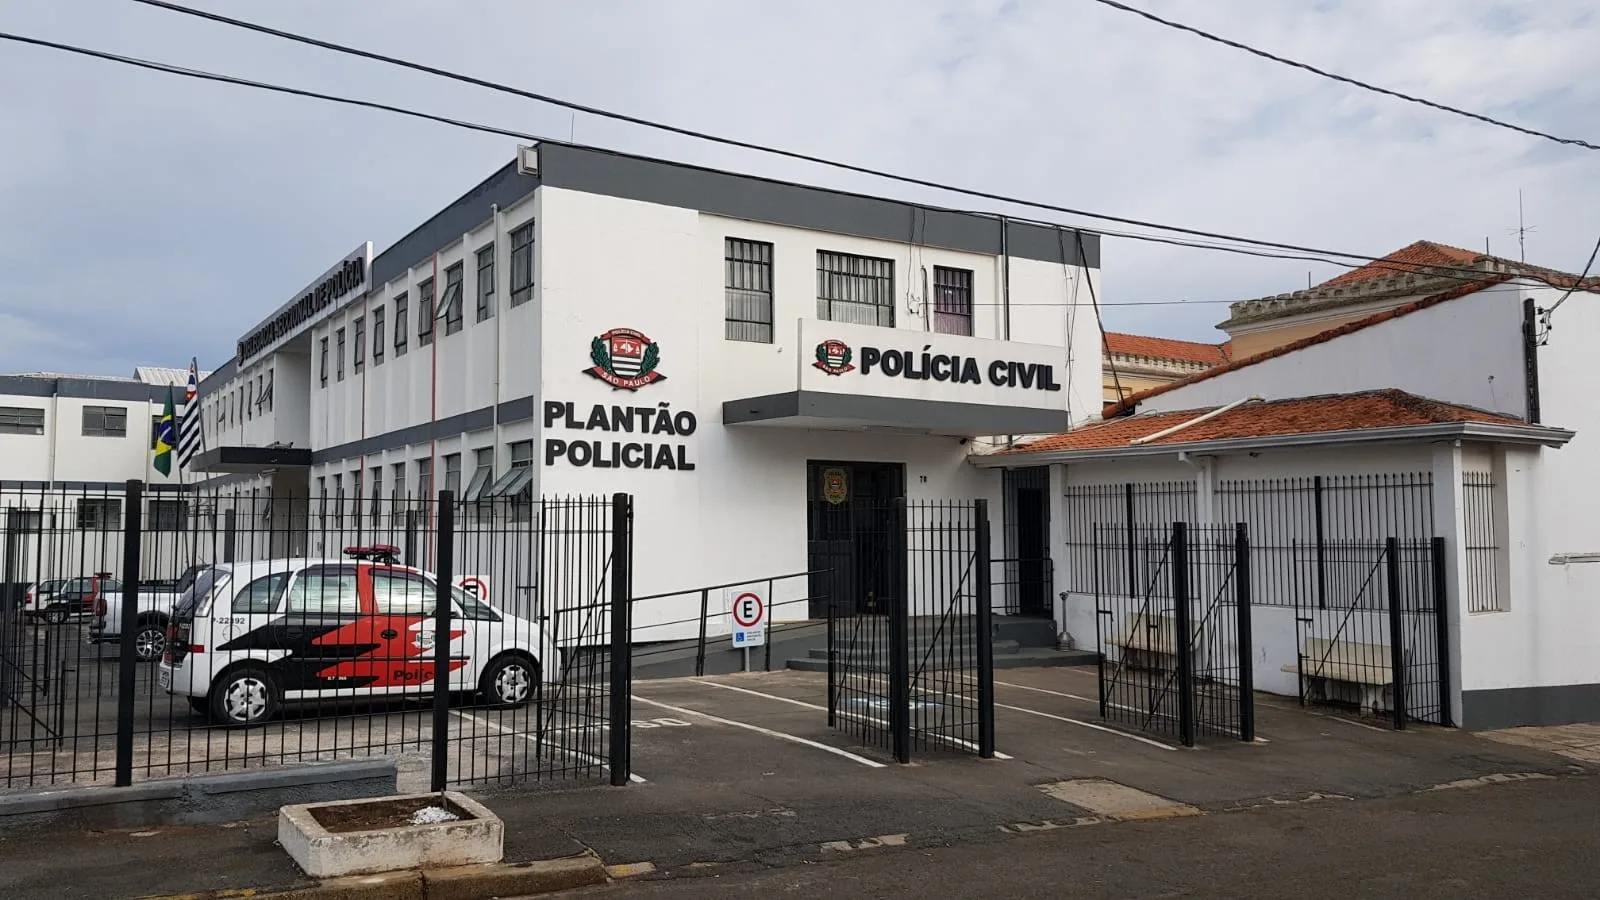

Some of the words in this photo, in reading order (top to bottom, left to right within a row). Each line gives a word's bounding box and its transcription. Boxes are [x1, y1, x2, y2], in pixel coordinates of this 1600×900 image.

[327, 256, 364, 304] POLÍCIA
[623, 376, 650, 387] PAULO
[860, 345, 981, 384] POLÍCIA
[988, 360, 1061, 391] CIVIL
[544, 401, 697, 436] PLANTÃO
[545, 438, 695, 471] POLICIAL
[212, 617, 245, 625] P-2292
[743, 600, 752, 618] E
